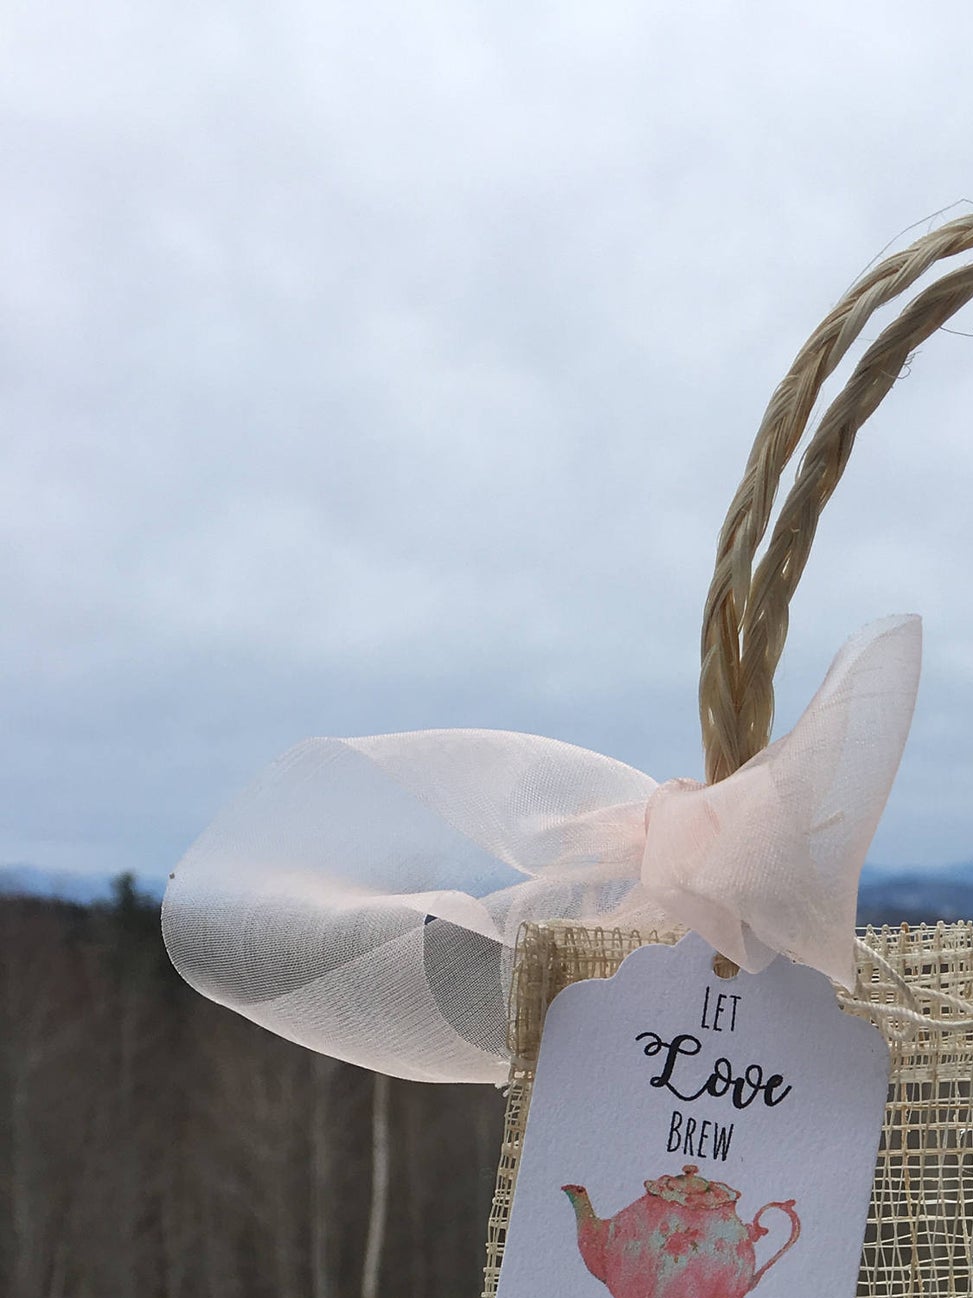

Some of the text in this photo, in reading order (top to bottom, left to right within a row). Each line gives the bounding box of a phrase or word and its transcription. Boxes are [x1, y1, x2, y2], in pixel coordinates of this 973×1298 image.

[701, 985, 742, 1032] LET
[635, 1031, 793, 1109] Love
[666, 1110, 734, 1161] BREW
